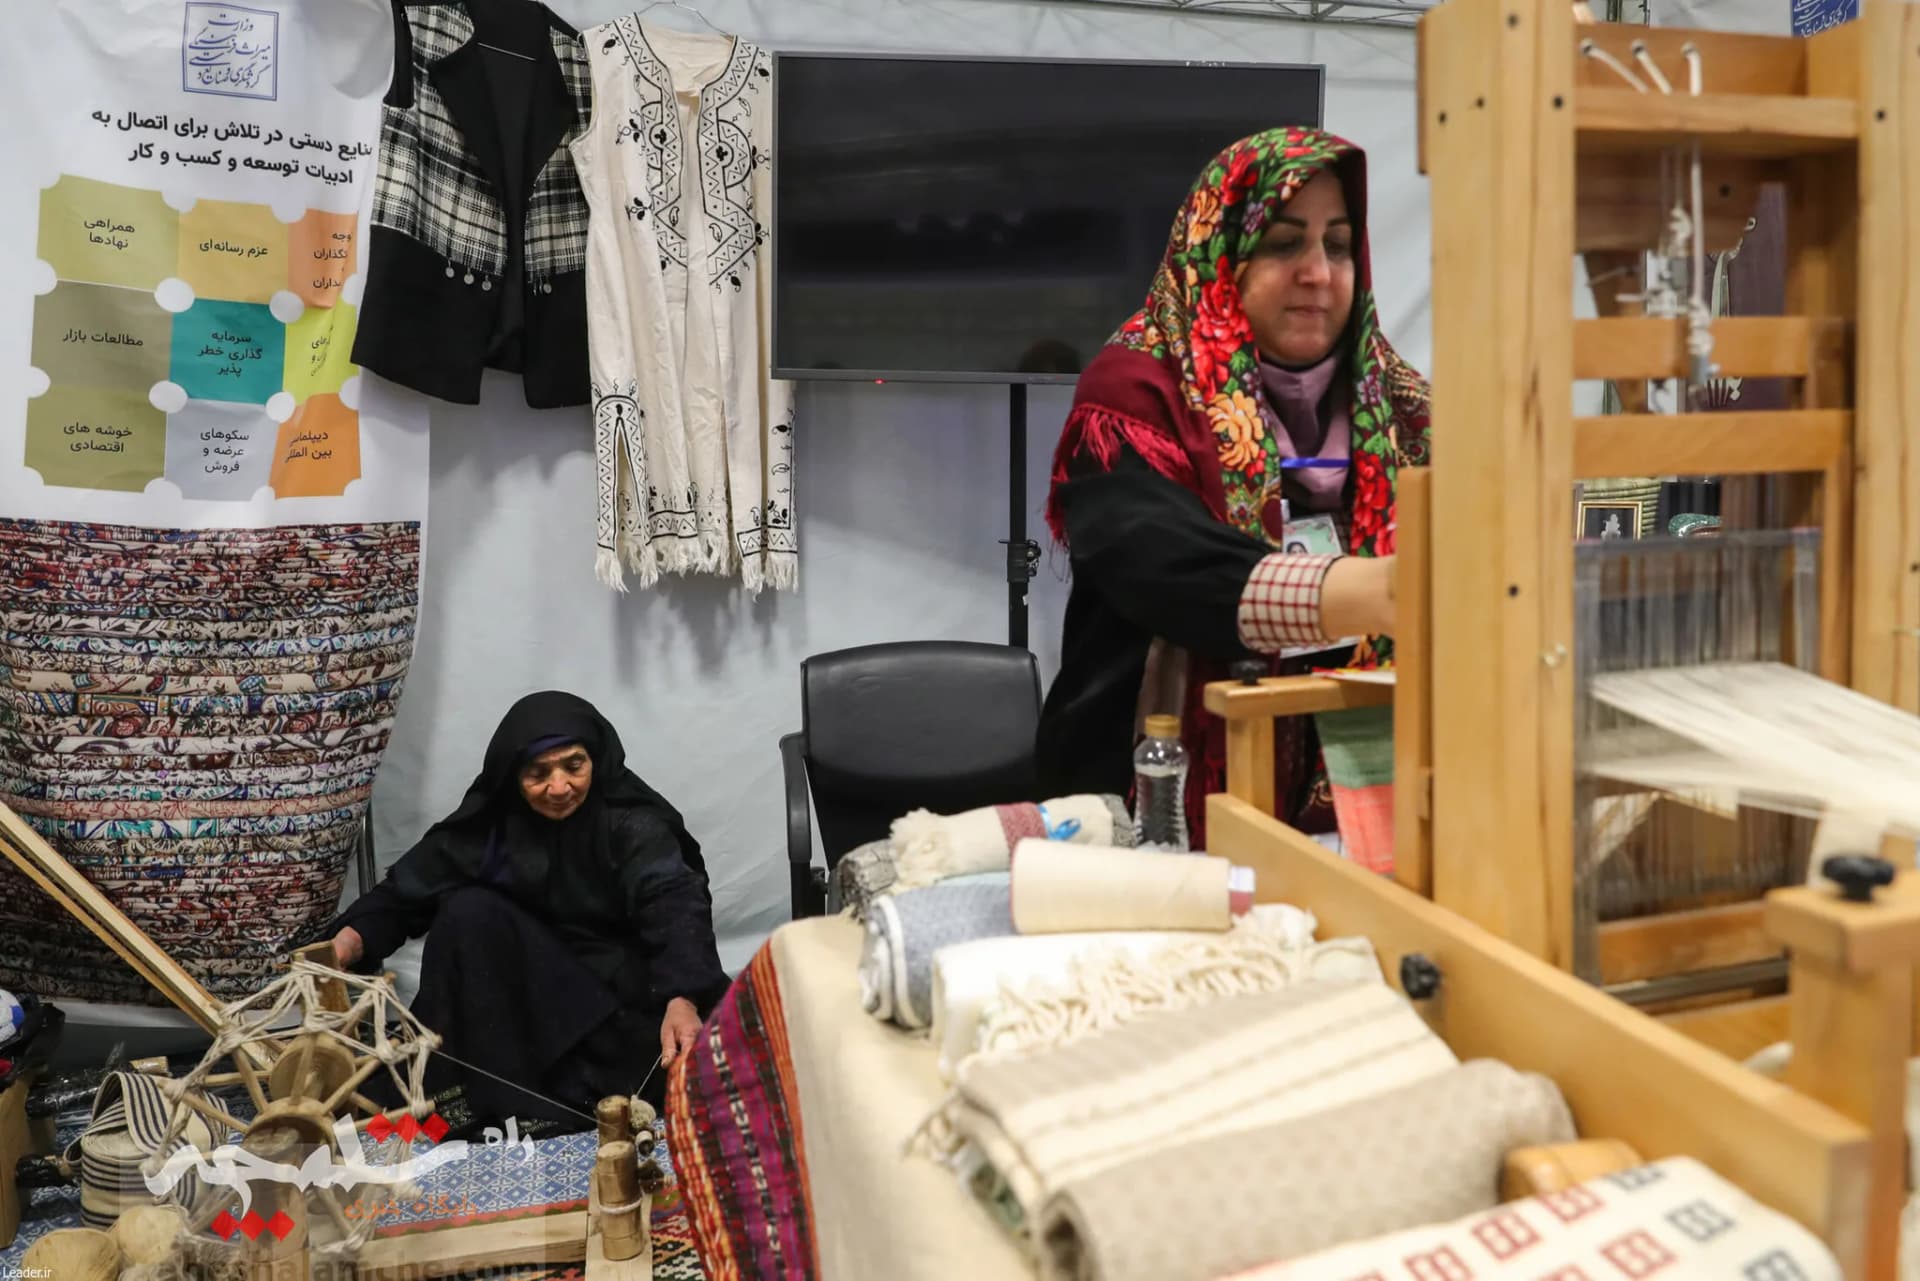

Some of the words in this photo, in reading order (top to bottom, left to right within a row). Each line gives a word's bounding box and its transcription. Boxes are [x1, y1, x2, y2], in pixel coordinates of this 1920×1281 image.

[92, 110, 111, 127] به
[117, 111, 168, 131] اتصال
[174, 117, 208, 138] برای
[214, 121, 260, 141] تلاش
[263, 129, 283, 145] در
[289, 132, 333, 152] دستی
[128, 142, 154, 161] کار
[160, 150, 170, 165] و
[176, 150, 222, 167] کسب
[338, 142, 373, 161] نایع
[228, 157, 237, 172] و
[243, 157, 300, 177] توسعه
[305, 165, 353, 186] ادبیات
[84, 218, 135, 233] همراهی
[89, 232, 129, 250] نهادها
[331, 232, 352, 243] وجه
[247, 246, 268, 258] عزم
[63, 328, 87, 342] بازار
[91, 332, 143, 347] مطالعات
[211, 330, 251, 344] سرمایه
[198, 345, 224, 357] خطر
[228, 347, 263, 361] گذاری
[217, 362, 242, 377] پذیر
[63, 422, 90, 435] های
[96, 426, 132, 437] خوشه
[200, 427, 250, 442] سکوهای
[70, 439, 124, 453] اقتصادی
[202, 446, 209, 456] و
[213, 446, 245, 459] عرضه
[311, 448, 332, 461] بین
[204, 460, 240, 474] فروش
